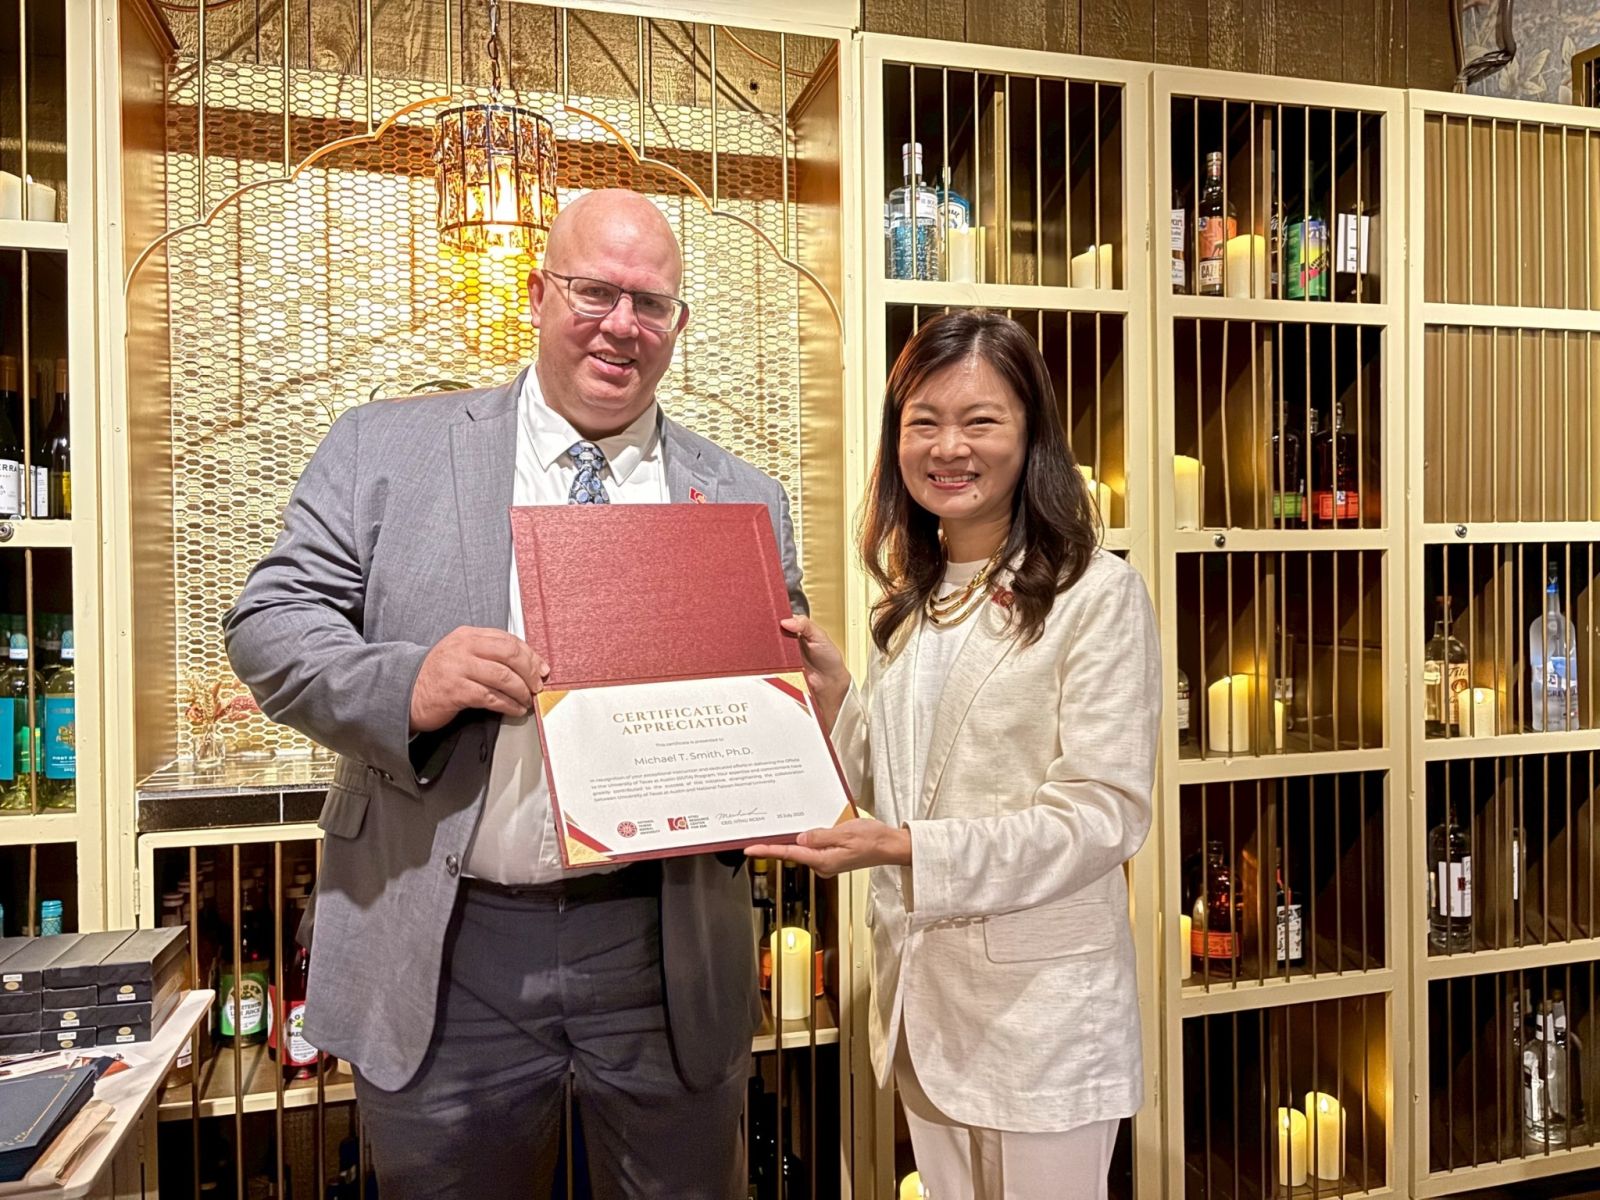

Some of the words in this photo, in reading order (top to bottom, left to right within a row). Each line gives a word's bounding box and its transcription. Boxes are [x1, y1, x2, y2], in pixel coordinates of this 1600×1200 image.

[612, 705, 724, 723] CERTIFICATE
[728, 702, 750, 713] OF
[622, 714, 748, 735] APPRECIATION
[634, 754, 676, 766] Michael
[678, 753, 688, 761] T.
[689, 750, 724, 761] Smith,
[725, 747, 754, 757] Ph.D.
